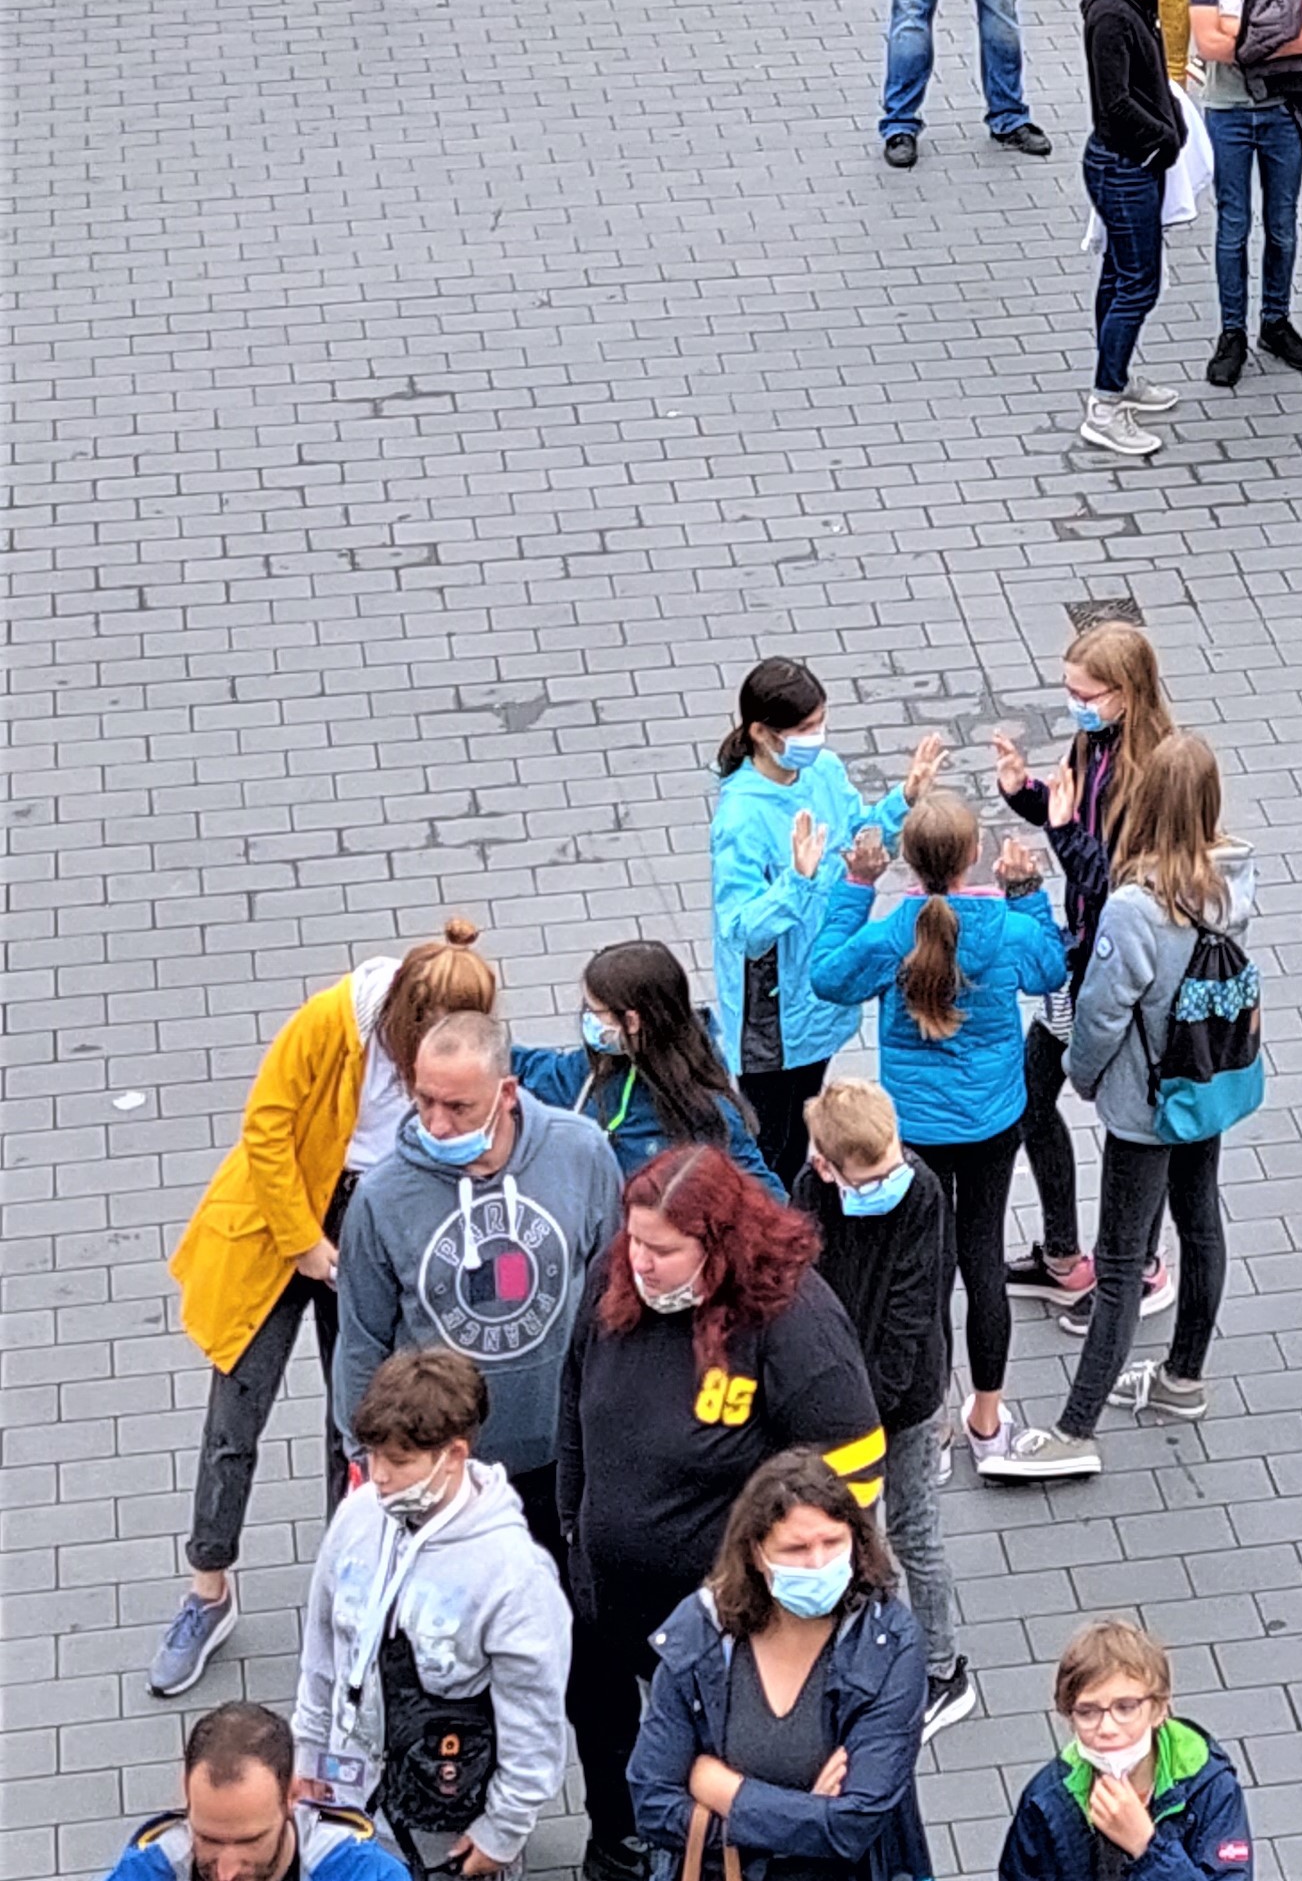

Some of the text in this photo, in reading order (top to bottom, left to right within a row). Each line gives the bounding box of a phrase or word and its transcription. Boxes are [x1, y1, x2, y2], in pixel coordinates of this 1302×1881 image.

[434, 1201, 551, 1267] PARIS
[440, 1290, 556, 1352] FRANCE
[694, 1366, 758, 1427] 85
